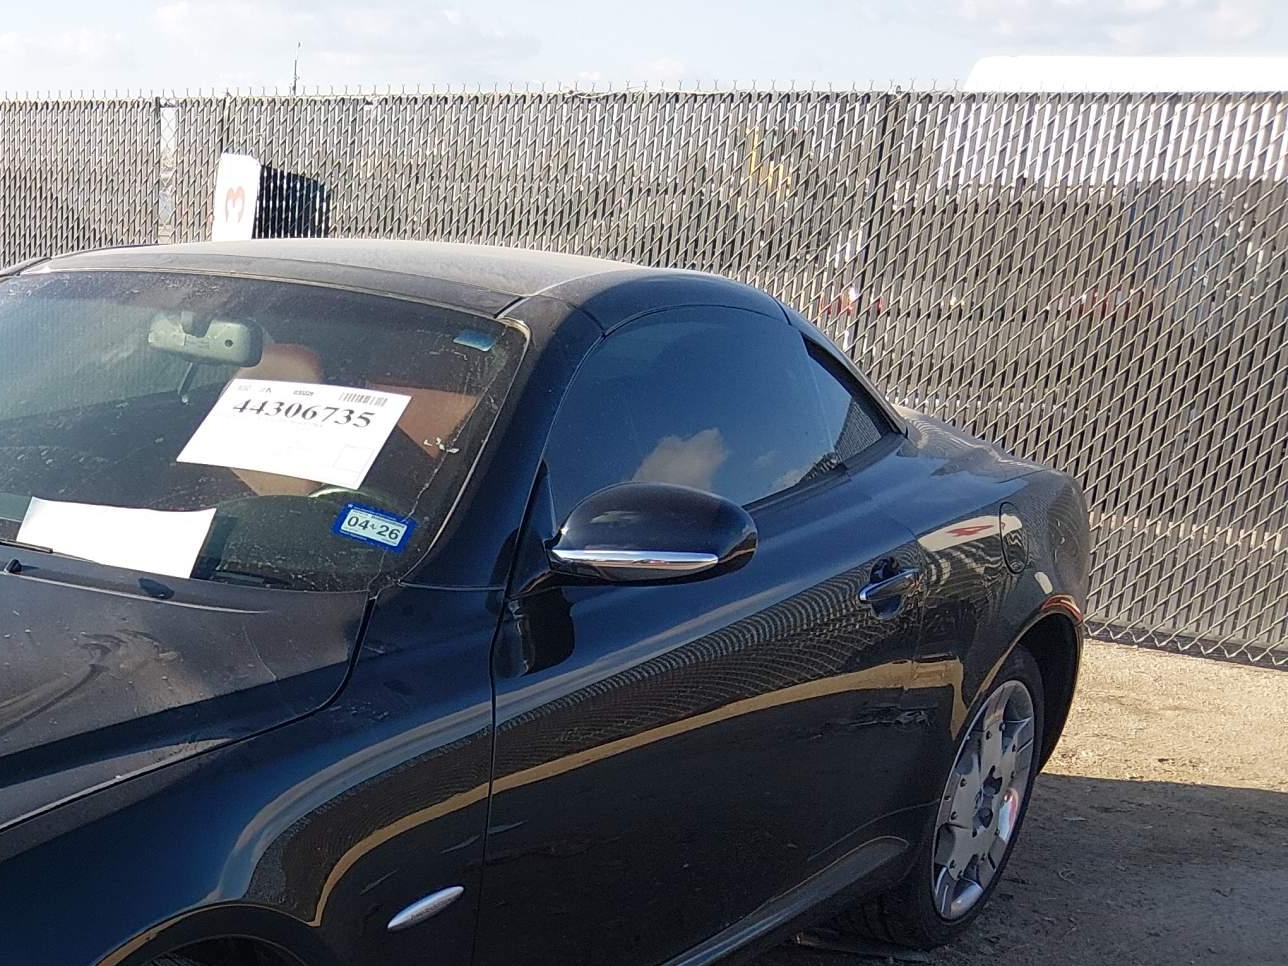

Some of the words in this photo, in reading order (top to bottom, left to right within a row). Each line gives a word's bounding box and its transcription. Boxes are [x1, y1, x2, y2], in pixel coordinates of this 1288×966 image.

[232, 399, 377, 428] 44306735
[347, 516, 370, 531] 04
[376, 525, 401, 540] 26
